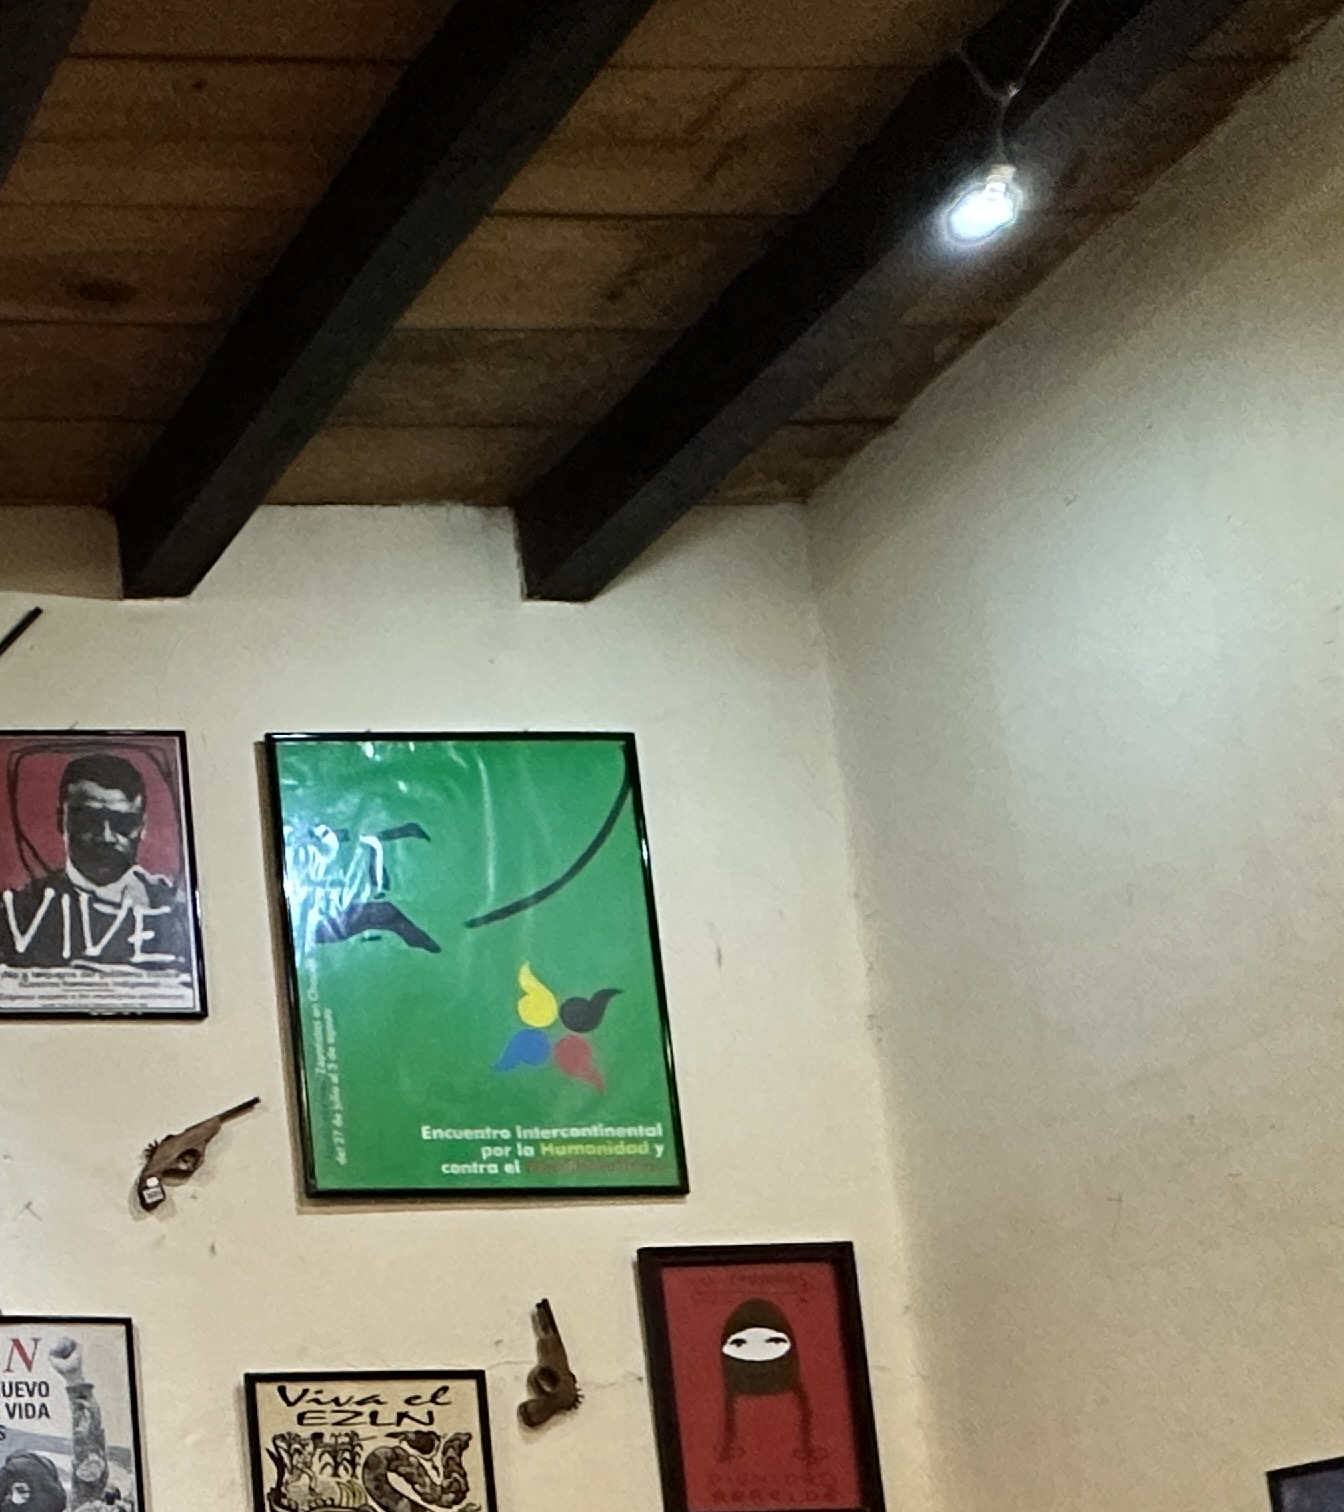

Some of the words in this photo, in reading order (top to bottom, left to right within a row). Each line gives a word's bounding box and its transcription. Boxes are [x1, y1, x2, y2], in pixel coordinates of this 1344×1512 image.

[420, 1124, 511, 1140] Encuentro
[516, 1122, 663, 1139] Intercontinental
[480, 1145, 512, 1160] por
[517, 1143, 535, 1157] la
[540, 1141, 650, 1157] Humanidad
[654, 1143, 664, 1158] y
[441, 1160, 499, 1174] contra
[504, 1159, 521, 1174] el
[277, 1385, 387, 1407] Viva
[404, 1385, 453, 1406] el
[4, 1402, 51, 1420] VIDA
[297, 1409, 435, 1427] EZLN
